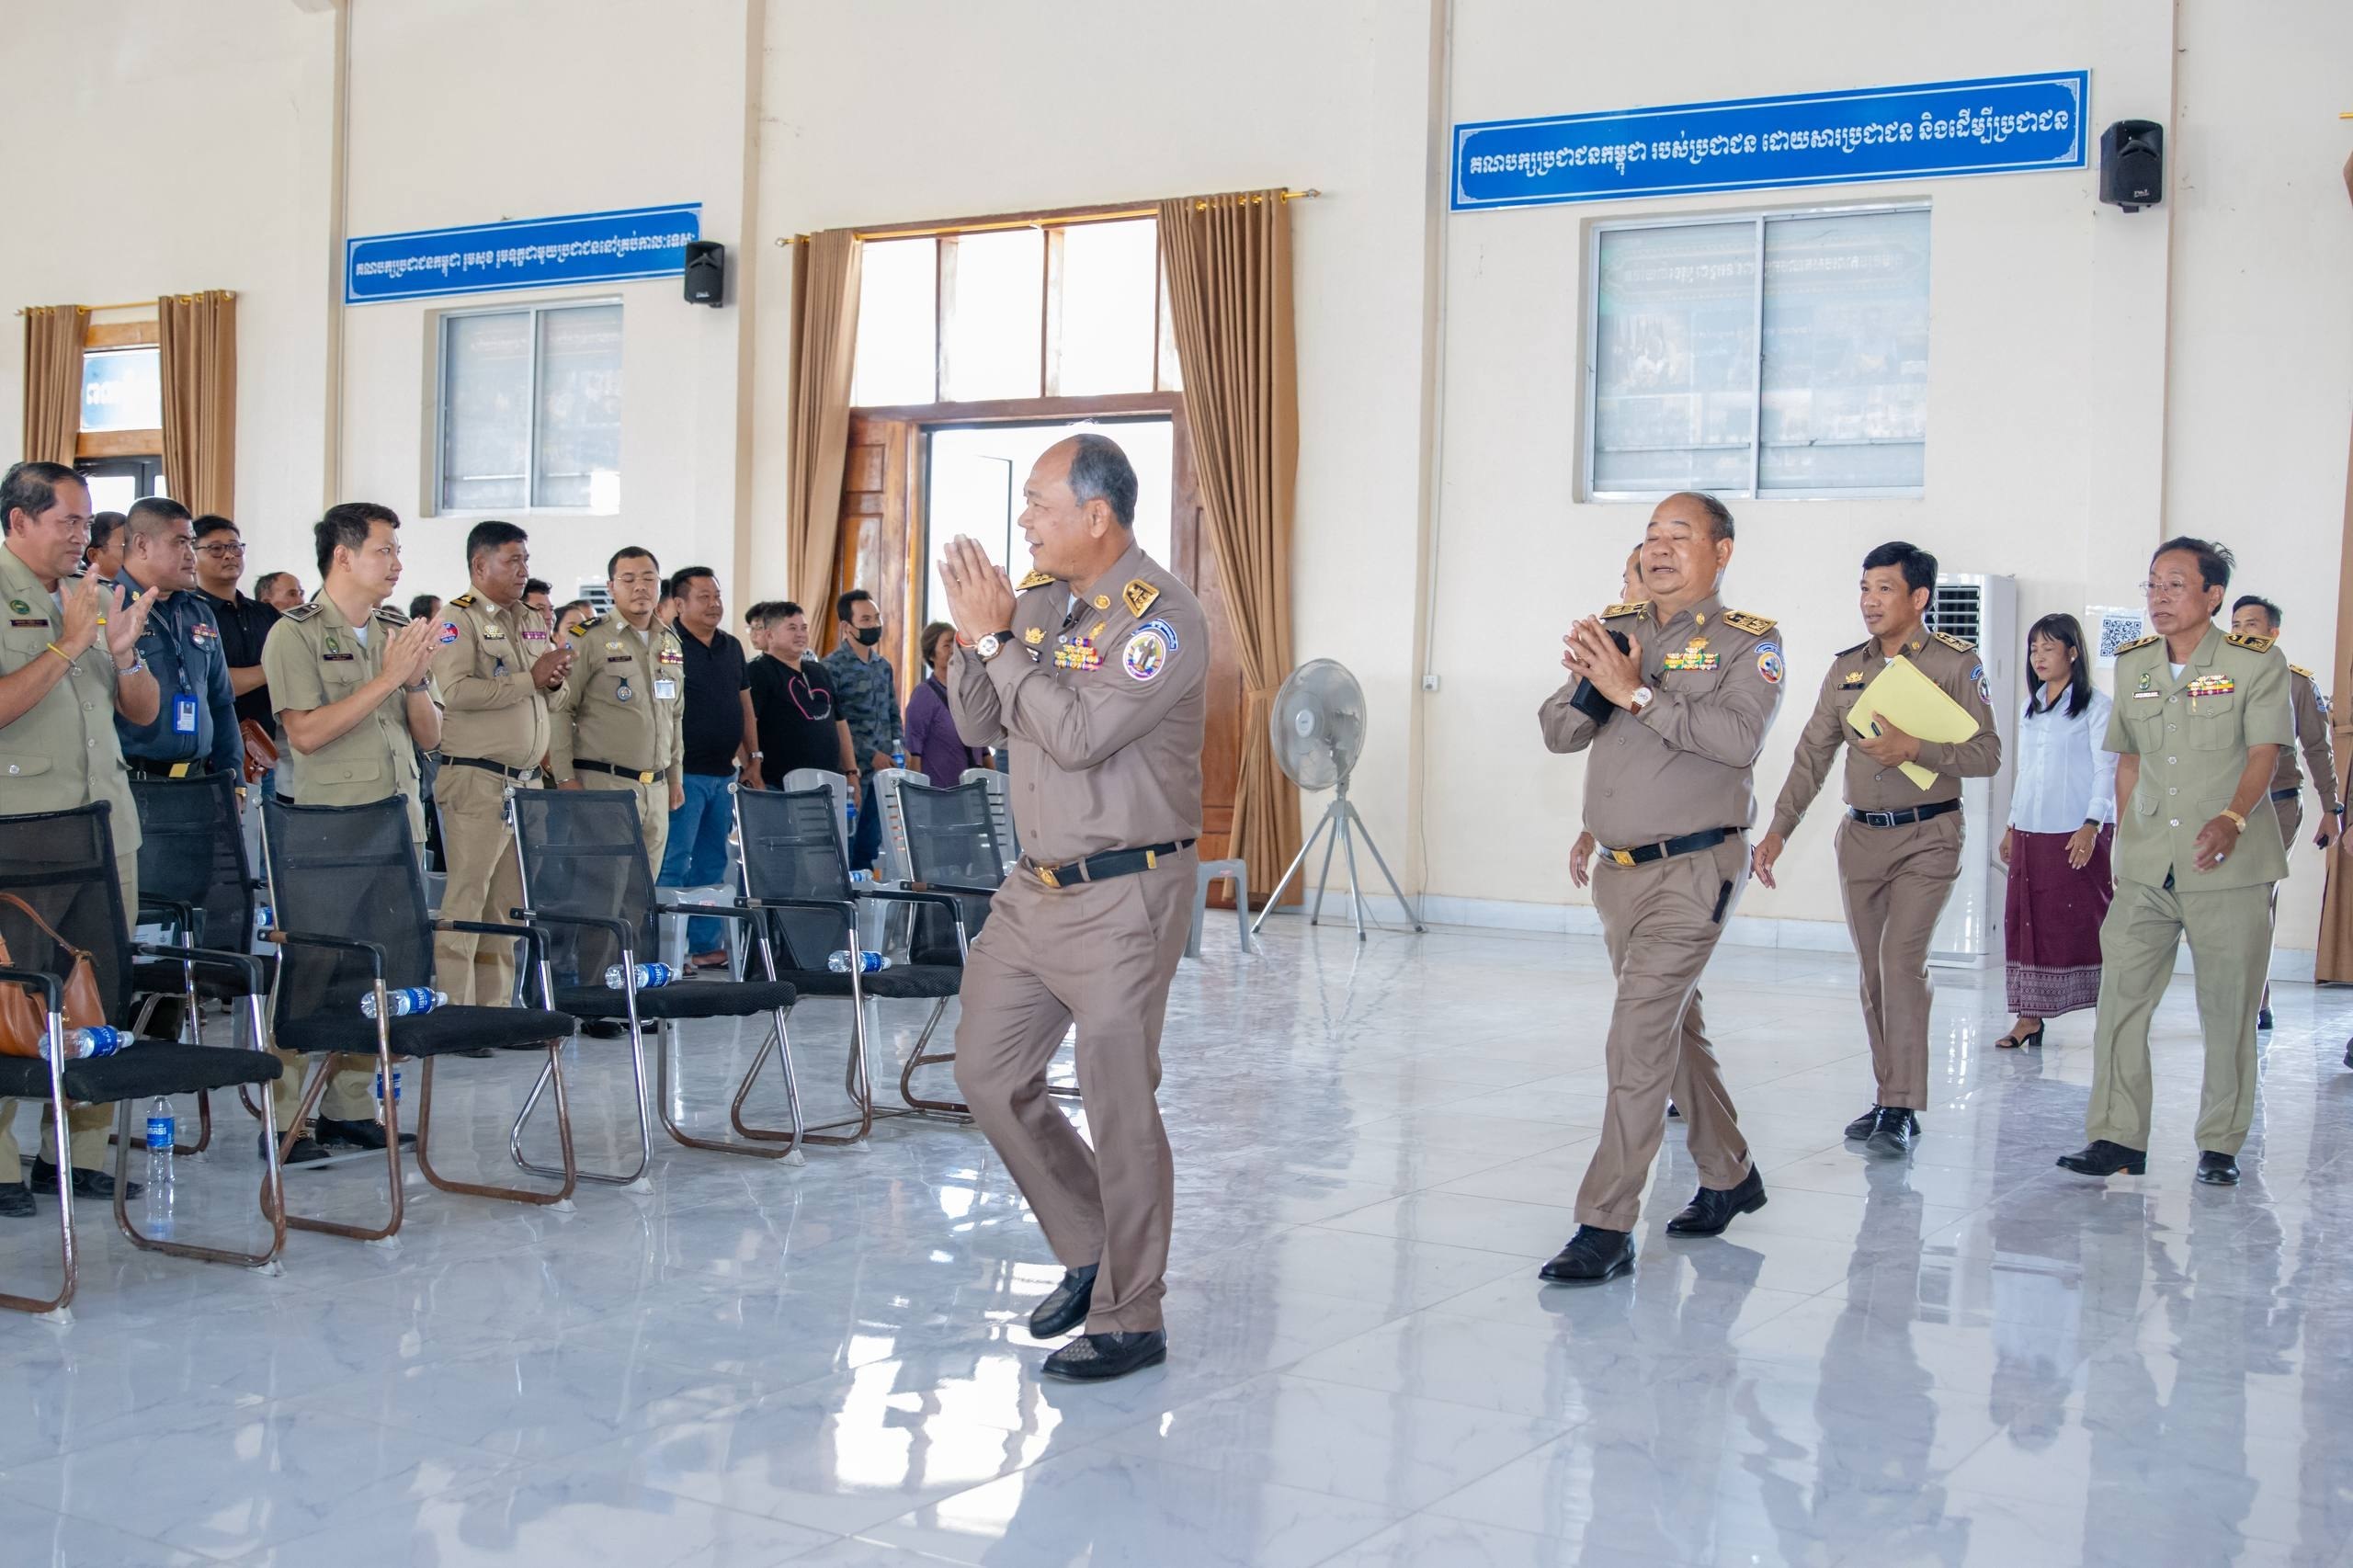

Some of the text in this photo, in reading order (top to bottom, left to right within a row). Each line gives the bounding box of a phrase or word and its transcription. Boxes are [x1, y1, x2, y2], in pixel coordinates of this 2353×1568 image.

[1470, 107, 2069, 176] គណបក្សប្រជាជនកម្ពុជា របស់ប្រជាជន ដោយសារប្រជាជន និងដើម្បីប្រជាជន
[356, 252, 460, 278] គណបក្សប្រជាជនកម្ពុជា
